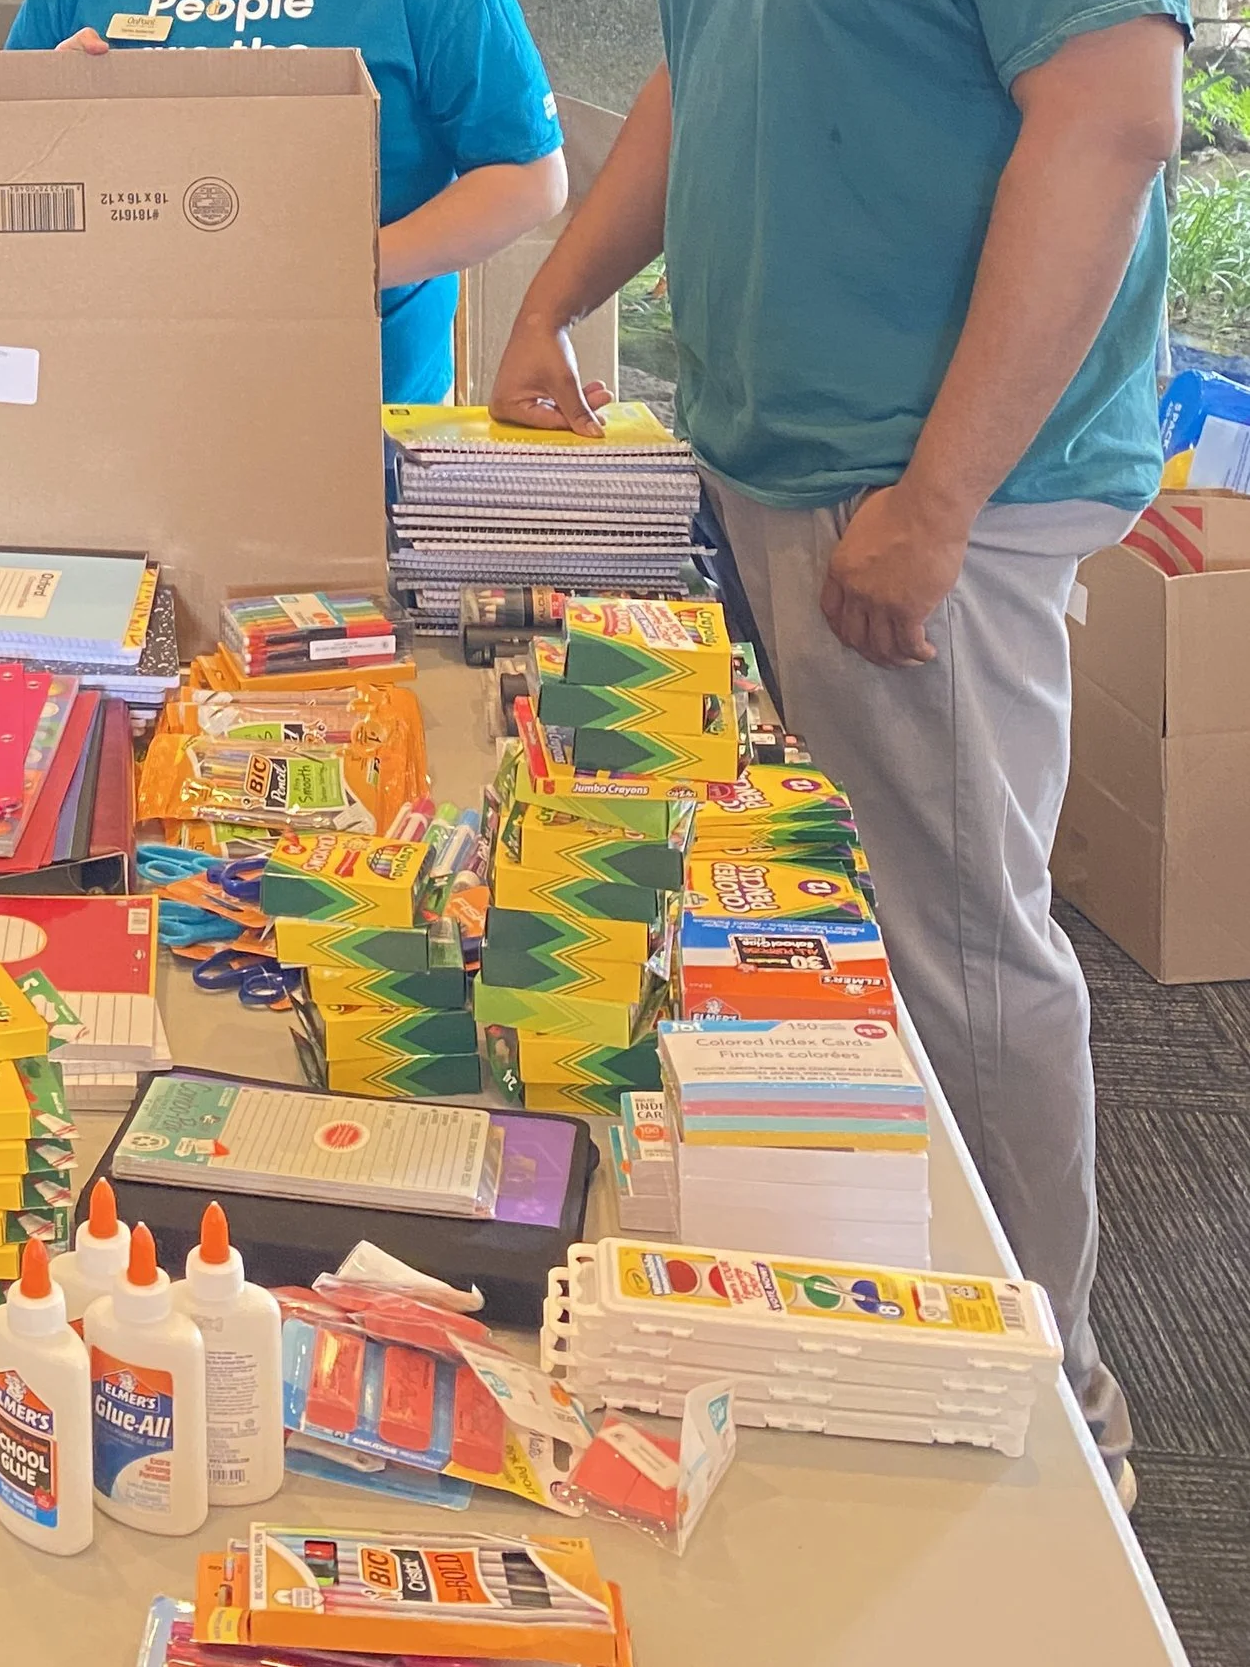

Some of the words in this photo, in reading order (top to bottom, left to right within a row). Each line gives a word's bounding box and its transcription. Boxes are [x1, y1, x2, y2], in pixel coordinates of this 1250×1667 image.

[100, 193, 115, 206] 12
[128, 193, 142, 204] 16
[155, 192, 169, 204] 18
[110, 209, 160, 221] #181612
[33, 572, 55, 597] Oxford
[699, 609, 718, 645] Crayola
[249, 758, 268, 794] BIC
[270, 758, 287, 803] Pencil
[297, 764, 311, 804] Smooth
[572, 782, 607, 795] Jumbo
[608, 784, 649, 797] Crayons
[713, 861, 749, 914] COLORED
[743, 864, 779, 912] PENCILS
[807, 880, 830, 895] 12
[790, 955, 824, 970] 30
[822, 975, 883, 985] ELMER'S
[788, 1022, 818, 1031] 150
[696, 1036, 764, 1048] Colored
[769, 1037, 818, 1048] Index
[822, 1037, 872, 1048] Cards
[637, 1111, 664, 1119] CAR
[886, 1305, 901, 1318] 8
[104, 1383, 157, 1410] ELMER'S
[94, 1394, 172, 1439] Glue-All
[0, 1453, 37, 1487] GLUE
[406, 1557, 427, 1592] Cristal
[445, 1552, 467, 1589] BOLD
